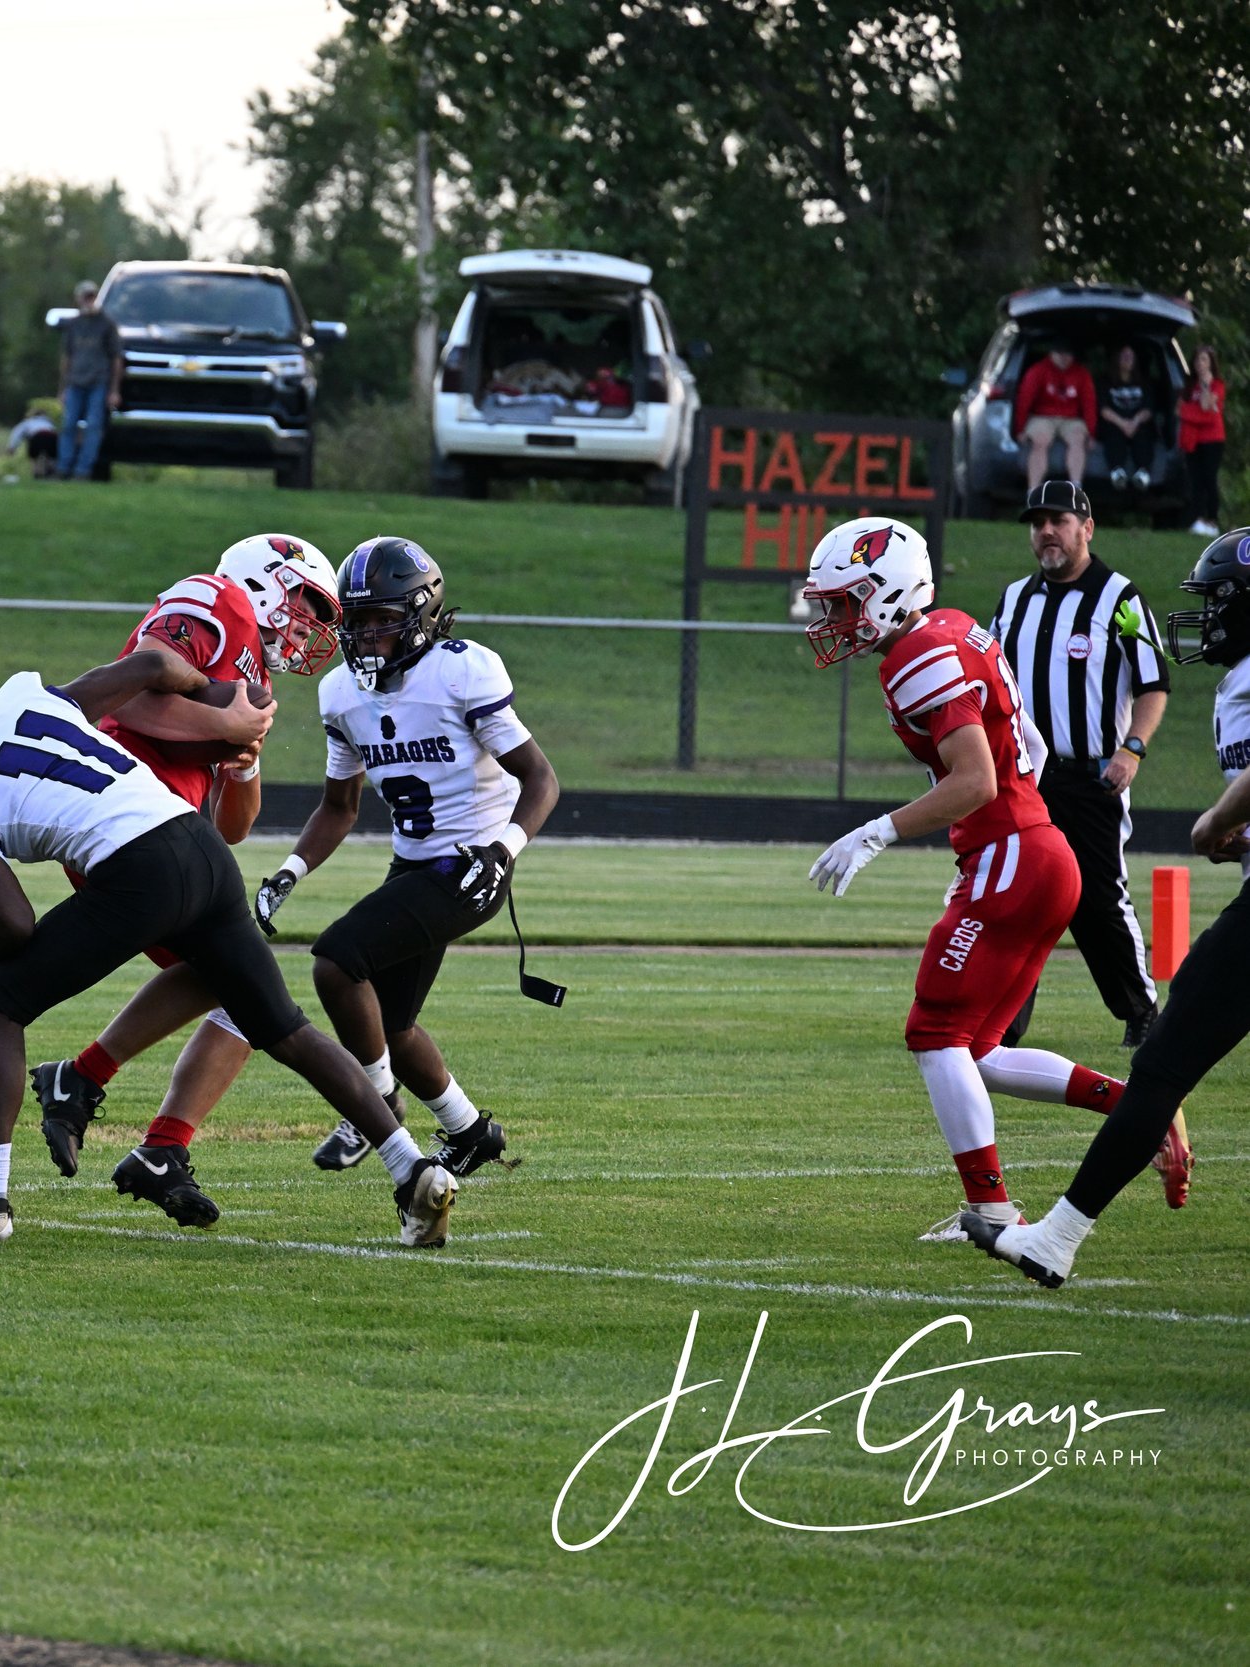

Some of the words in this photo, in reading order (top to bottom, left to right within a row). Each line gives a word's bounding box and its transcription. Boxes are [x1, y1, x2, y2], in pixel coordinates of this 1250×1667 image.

[708, 426, 935, 499] HAZEL
[741, 503, 872, 571] HI
[405, 547, 430, 573] 8
[346, 589, 371, 598] Riddell
[441, 640, 468, 654] 8
[355, 736, 456, 771] HARAOHS
[381, 774, 435, 840] 8
[939, 918, 984, 972] CARDS
